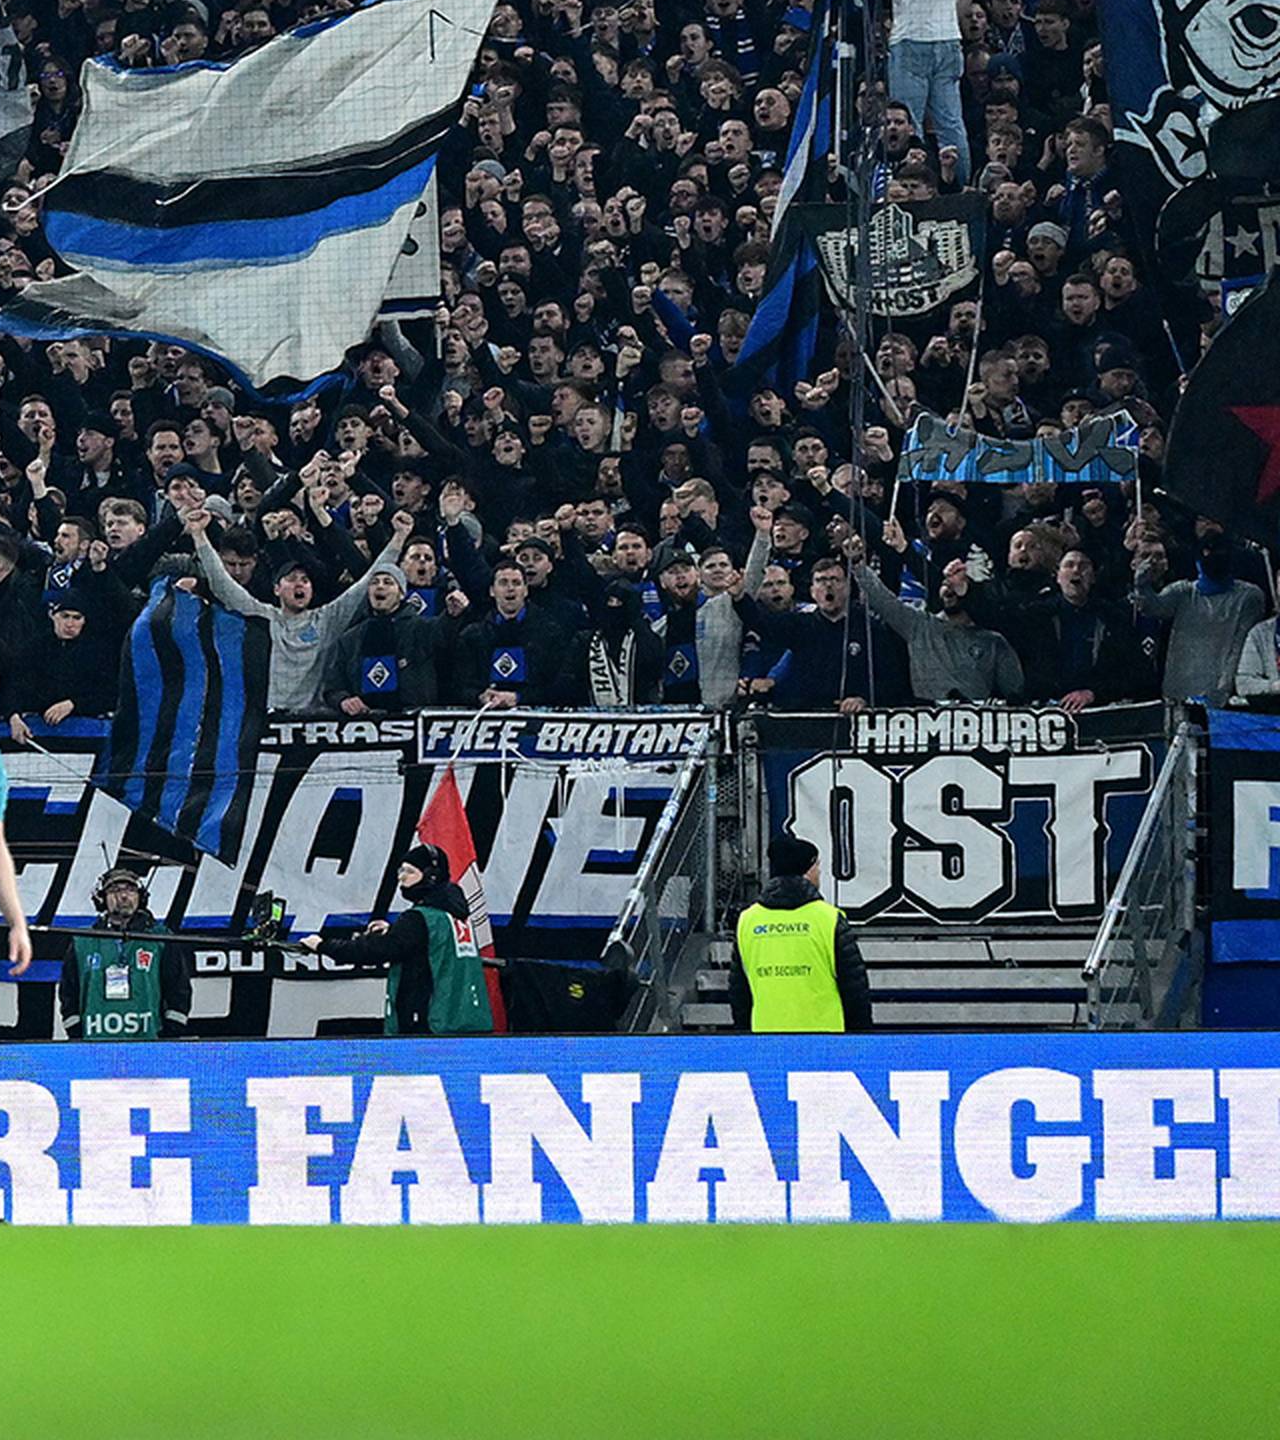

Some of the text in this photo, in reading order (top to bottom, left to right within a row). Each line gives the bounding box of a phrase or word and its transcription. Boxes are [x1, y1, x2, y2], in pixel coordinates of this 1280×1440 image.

[260, 721, 415, 745] TRAS
[427, 721, 711, 755] FREE BRATANS
[856, 711, 1068, 753] HAMBURG
[792, 750, 1142, 911] OST
[769, 922, 811, 934] POWER
[194, 950, 264, 972] DU
[775, 964, 812, 977] SECURITY
[86, 1011, 152, 1035] HOST
